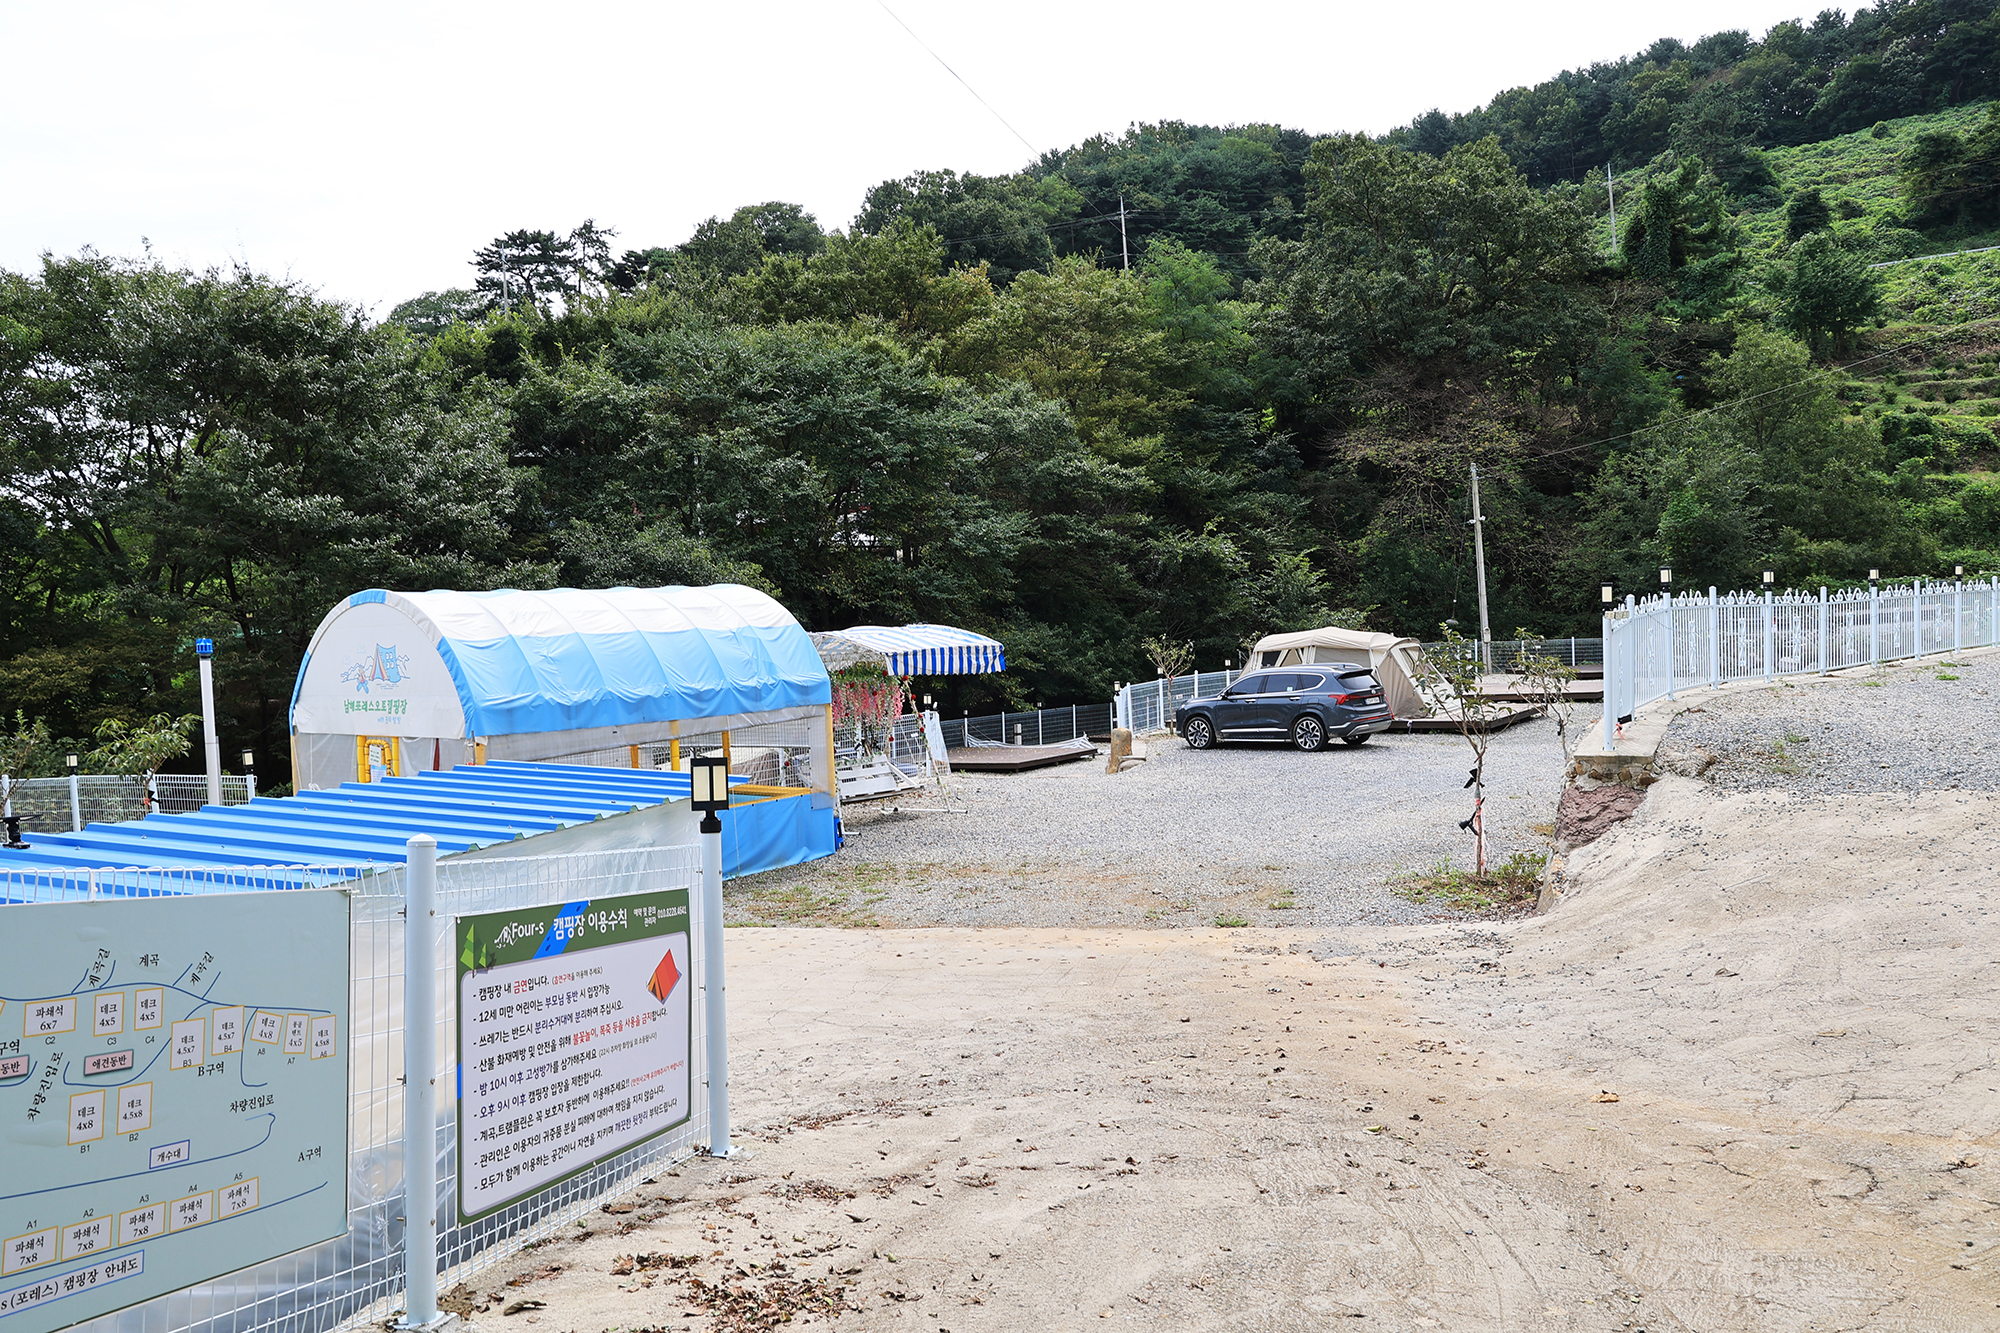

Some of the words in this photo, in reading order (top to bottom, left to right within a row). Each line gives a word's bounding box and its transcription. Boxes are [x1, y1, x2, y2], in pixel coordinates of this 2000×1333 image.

[553, 914, 586, 940] 캠핑장
[588, 908, 628, 934] 이용수칙
[139, 954, 160, 967] 계곡
[89, 948, 110, 988] 계곡길
[190, 951, 214, 986] 계곡길
[479, 984, 502, 1002] 캠핑장
[504, 983, 512, 994] 내
[514, 976, 550, 994] 금연입니다.
[100, 1004, 118, 1014] 데크
[140, 999, 157, 1010] 데크
[479, 1008, 497, 1022] 12세
[500, 1005, 514, 1018] 미만
[516, 1000, 544, 1015] 어린이는
[545, 993, 564, 1009] 부모님
[566, 990, 578, 1004] 동반
[580, 988, 586, 998] 시
[588, 984, 610, 999] 입장가능
[36, 1004, 64, 1018] 파쇄석
[140, 1012, 156, 1022] 4x5
[40, 1020, 58, 1031] 6x7
[100, 1017, 116, 1027] 4x5
[222, 1022, 234, 1031] 데크
[262, 1017, 276, 1028] 데크
[479, 1030, 510, 1047] 쓰레기는
[512, 1023, 533, 1040] 반드시
[575, 1006, 598, 1024] 분리하여
[600, 1000, 624, 1016] 주십시오.
[45, 1036, 56, 1045] C2
[145, 1036, 156, 1044] C4
[182, 1036, 194, 1044] 데크
[258, 1029, 274, 1040] 4x8
[107, 1037, 117, 1046] C3
[224, 1044, 232, 1052] B4
[479, 1056, 495, 1072] 산불
[497, 1048, 526, 1066] 화재예방
[528, 1045, 536, 1059] 및
[536, 1038, 557, 1056] 안전을
[558, 1034, 572, 1048] 위해
[573, 1028, 598, 1046] 불꽃놀이,
[600, 1023, 611, 1036] 폭죽
[612, 1019, 623, 1034] 등을
[625, 1014, 640, 1028] 사용을
[257, 1048, 266, 1056] A8
[92, 1054, 127, 1070] 애견동반
[182, 1059, 192, 1067] B3
[198, 1061, 224, 1078] B구역
[480, 1082, 488, 1096] 밤
[490, 1076, 507, 1092] 10시
[509, 1070, 524, 1084] 이후
[526, 1060, 559, 1080] 고성방가를
[560, 1048, 597, 1071] 삼가해주세요
[27, 1052, 64, 1122] 차량진입로
[480, 1104, 496, 1118] 오후
[498, 1099, 510, 1112] 9시
[512, 1093, 526, 1106] 이후
[528, 1086, 548, 1104] 캠핑장
[550, 1078, 570, 1096] 입장을
[571, 1068, 602, 1086] 제한합니다.
[128, 1099, 142, 1108] 데크
[230, 1094, 274, 1114] 차량진입로
[536, 1110, 542, 1122] 꼭
[544, 1104, 564, 1120] 보호자
[566, 1092, 590, 1112] 동반하에
[78, 1106, 96, 1118] 데크
[76, 1120, 94, 1131] 4x8
[480, 1145, 511, 1168] 관리인은
[513, 1134, 541, 1152] 이용자의
[564, 1119, 576, 1135] 분실
[578, 1112, 596, 1126] 피해에
[596, 1104, 614, 1120] 대하여
[615, 1098, 632, 1112] 책임을
[632, 1094, 644, 1105] 지지
[129, 1132, 139, 1142] B2
[80, 1144, 91, 1154] B1
[480, 1172, 504, 1190] 모두가
[506, 1164, 520, 1182] 함께
[522, 1154, 550, 1172] 이용하는
[551, 1141, 576, 1162] 공간이니
[578, 1132, 596, 1148] 자연을
[596, 1124, 614, 1140] 지키며
[615, 1117, 632, 1132] 깨끗한
[632, 1110, 648, 1126] 뒷정리
[649, 1098, 678, 1118] 부탁드립니다
[157, 1148, 181, 1162] 개수대
[234, 1172, 243, 1181] A5
[188, 1184, 198, 1193] A4
[227, 1184, 250, 1200] 파쇄석
[139, 1194, 150, 1204] A3
[231, 1197, 248, 1211] 7x8
[179, 1198, 203, 1214] 파쇄석
[83, 1208, 94, 1218] A2
[128, 1210, 155, 1226] 파쇄석
[182, 1212, 198, 1226] 7x8
[26, 1220, 38, 1230] A1
[133, 1225, 150, 1238] 7x8
[73, 1224, 100, 1240] 파쇄석
[15, 1236, 44, 1253] 파쇄석
[77, 1240, 94, 1253] 7x8
[20, 1252, 38, 1266] 7x8
[10, 1282, 58, 1308] (포레스)
[63, 1268, 99, 1292] 캠핑장
[104, 1258, 138, 1278] 안내도
